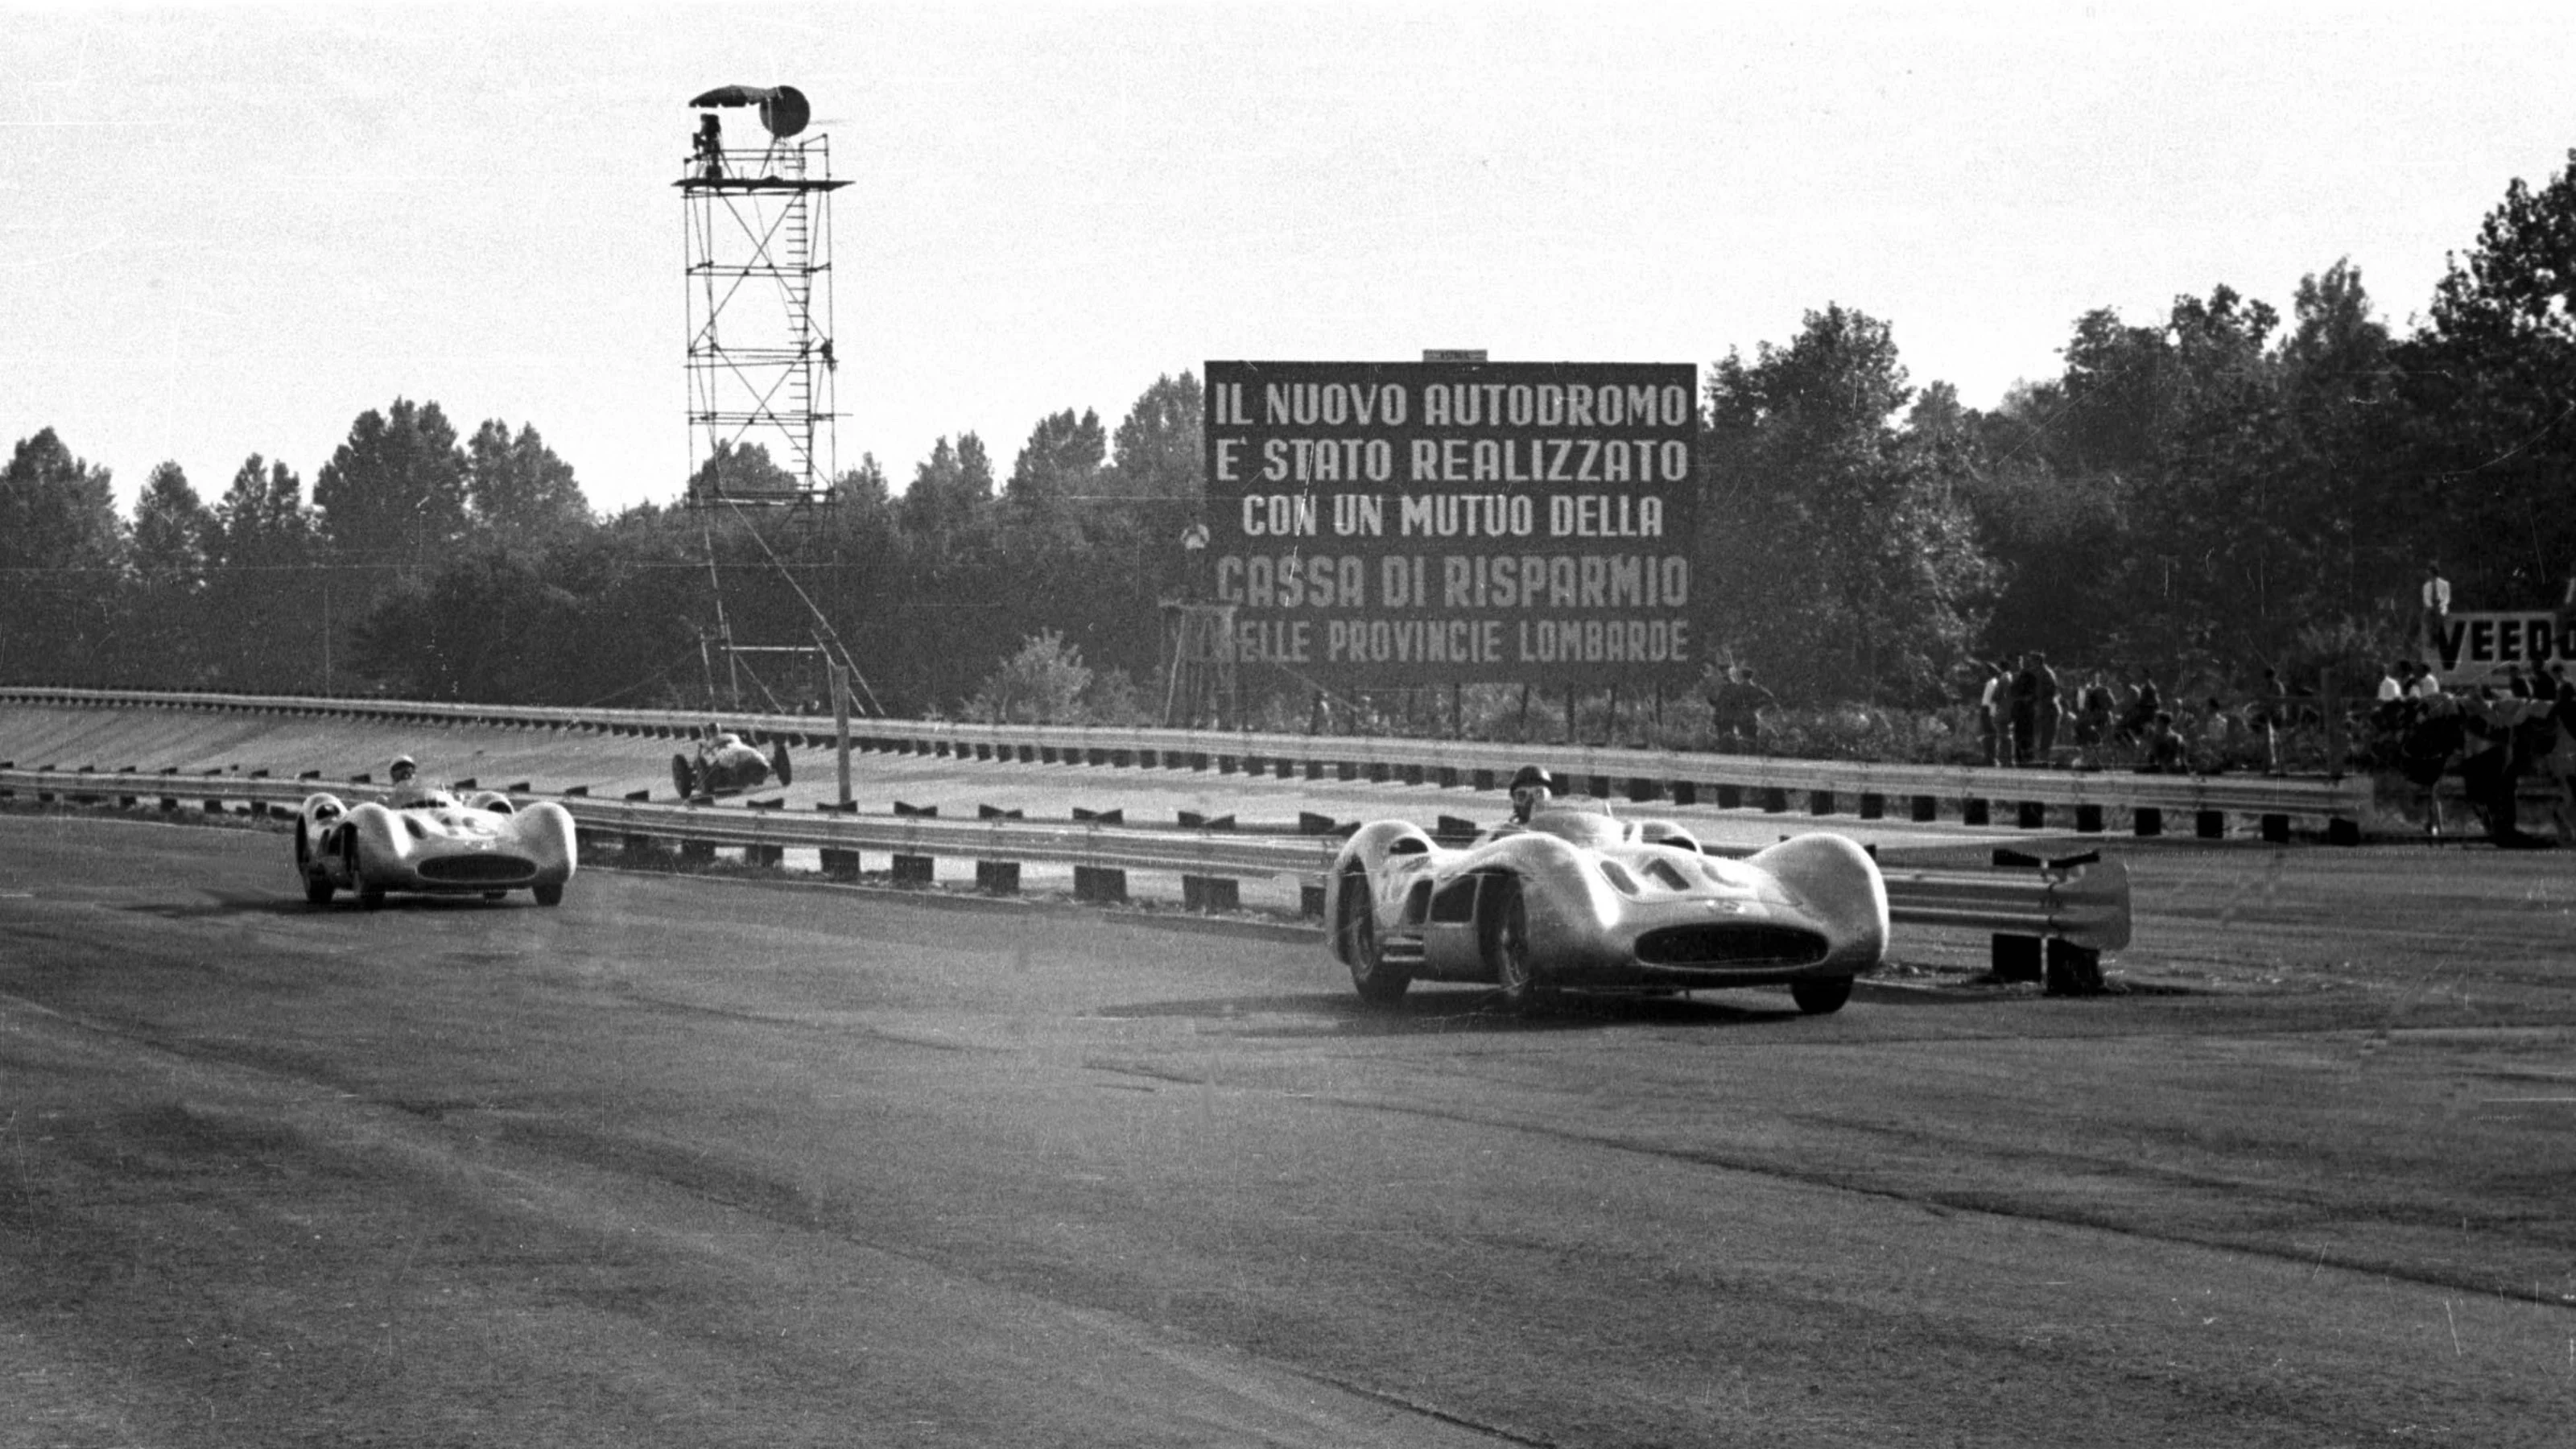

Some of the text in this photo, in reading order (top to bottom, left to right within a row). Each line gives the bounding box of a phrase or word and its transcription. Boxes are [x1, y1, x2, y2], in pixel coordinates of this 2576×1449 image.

[1216, 382, 1688, 426] IL NUOVO AUTODROMO
[1264, 439, 1392, 481] STATO
[1411, 440, 1688, 481] REALIZZATO
[1243, 494, 1663, 537] CON UN MUTUO DELLA
[1217, 555, 1688, 607] CASSA DI RISPARMIO
[1222, 620, 1689, 662] ELLE PROVINCIE LOMBARDE
